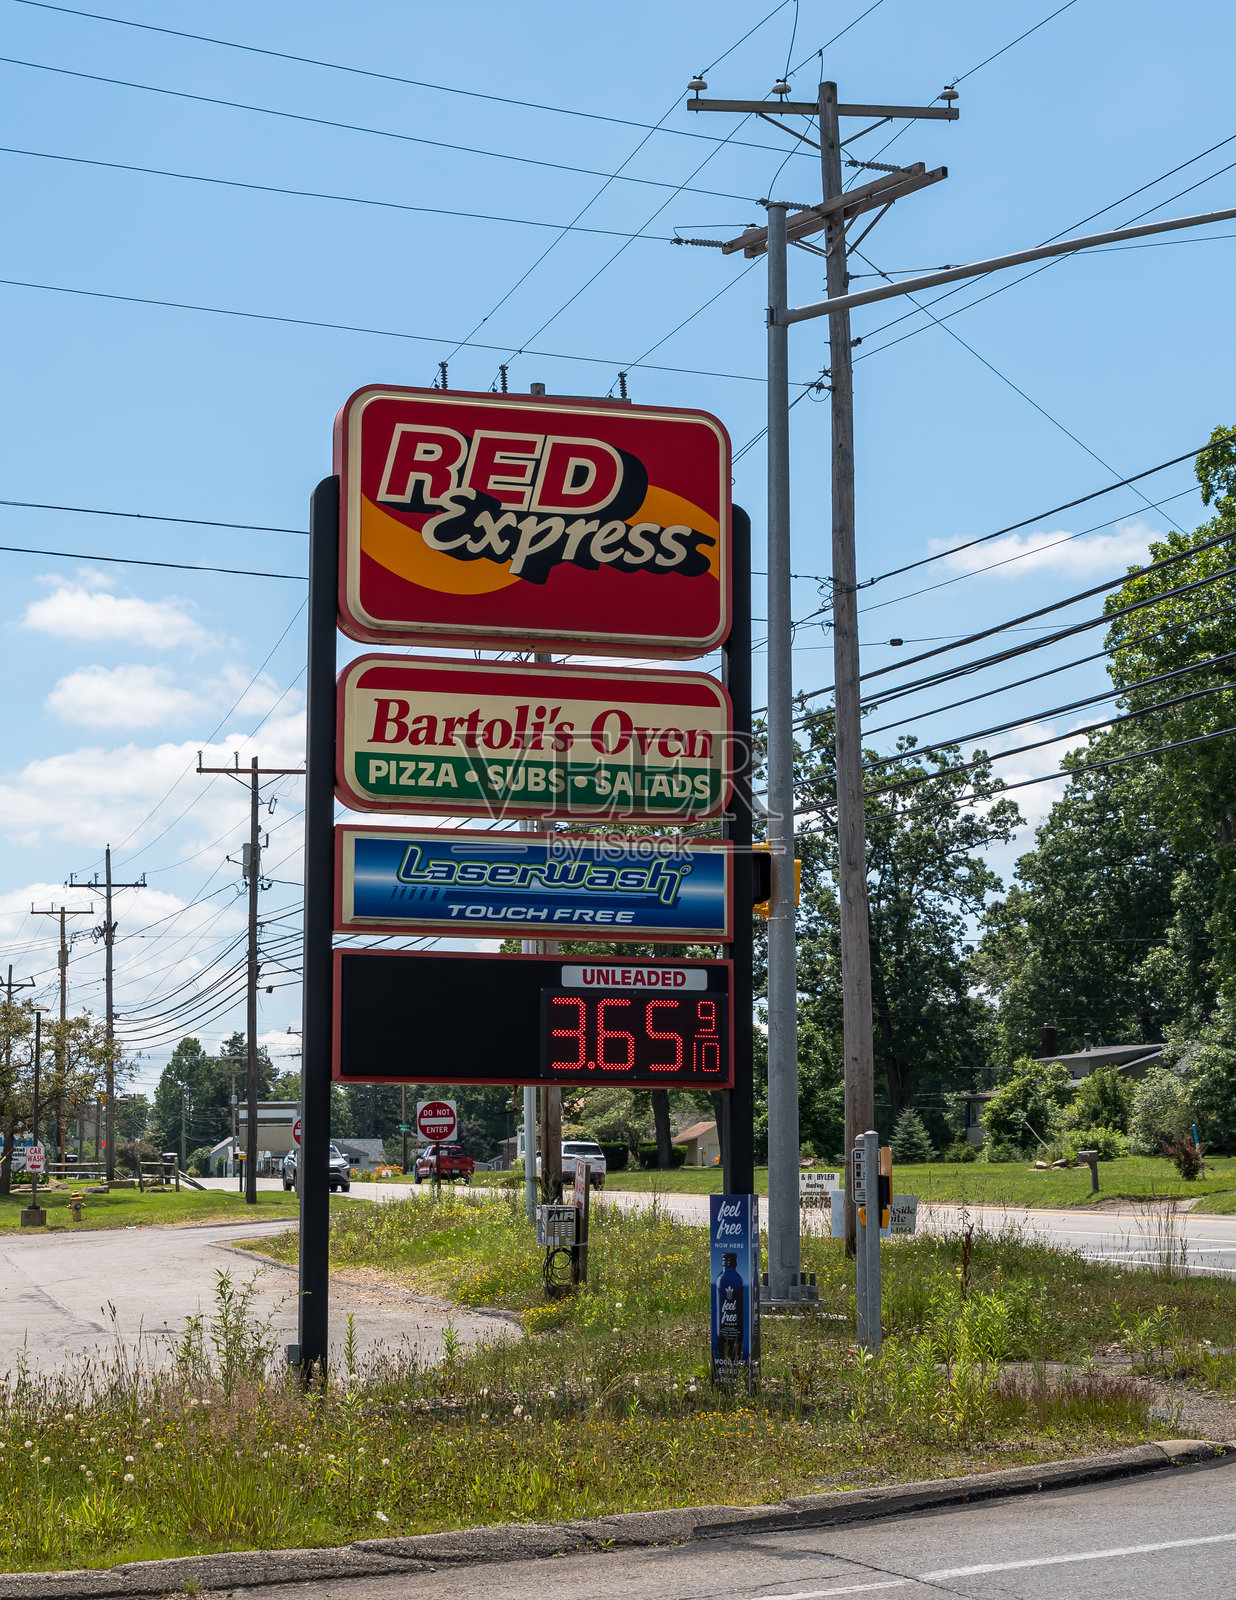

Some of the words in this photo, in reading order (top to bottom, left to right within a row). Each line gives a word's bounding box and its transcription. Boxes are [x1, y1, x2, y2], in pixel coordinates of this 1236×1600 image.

[377, 423, 625, 514] RED
[421, 487, 693, 574] Express
[367, 697, 575, 752] Bartoli's
[590, 708, 715, 759] Oven
[368, 759, 459, 788] PIZZA
[486, 765, 566, 792] SUBS
[595, 770, 711, 799] SALADS
[447, 904, 549, 922] TOUCH
[553, 909, 636, 924] FREE
[582, 968, 687, 987] UNLEADED
[551, 997, 683, 1071] 3.65
[697, 1000, 716, 1032] 9
[693, 1042, 720, 1073] 10
[423, 1109, 433, 1117] DO
[436, 1108, 451, 1116] NOT
[426, 1126, 449, 1134] ENTER
[29, 1147, 42, 1155] CAR
[816, 1173, 835, 1181] BYLER
[548, 1211, 575, 1222] AIR
[717, 1200, 741, 1221] feel
[716, 1218, 742, 1239] free
[721, 1299, 737, 1313] feel
[721, 1311, 738, 1324] free
